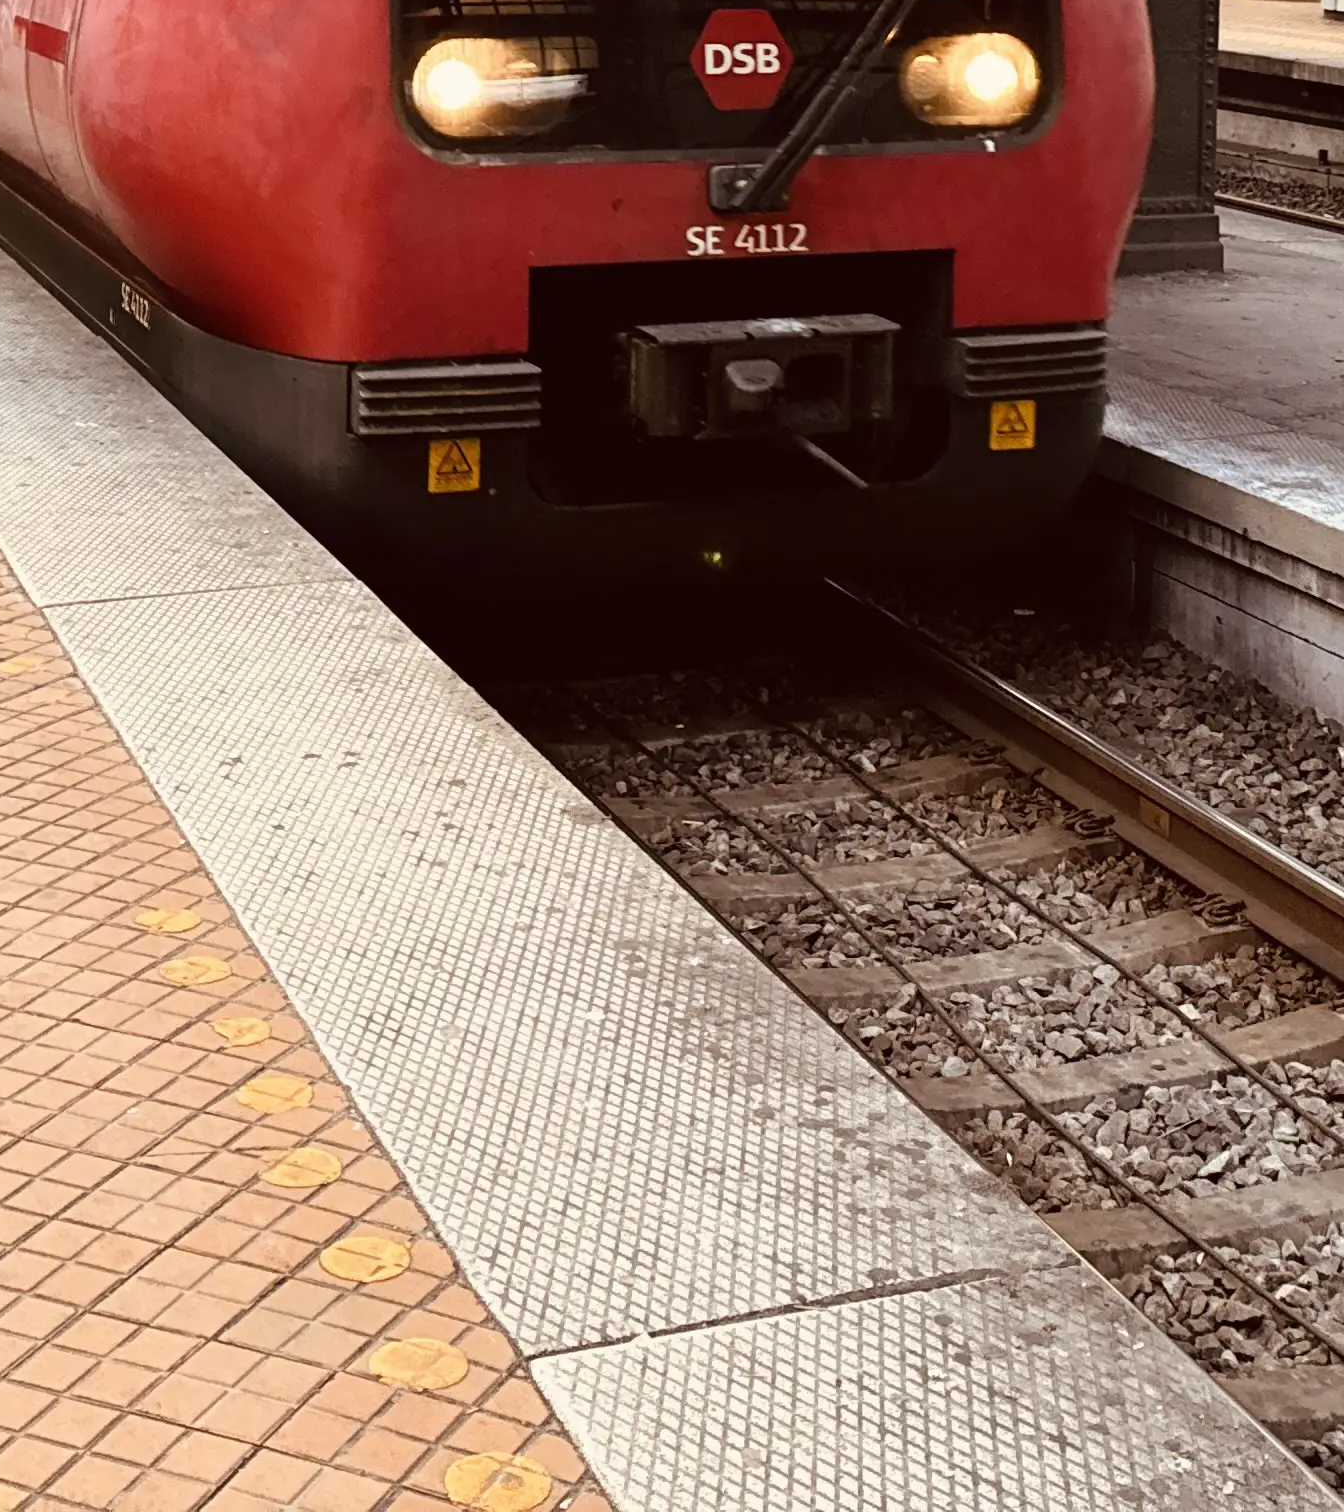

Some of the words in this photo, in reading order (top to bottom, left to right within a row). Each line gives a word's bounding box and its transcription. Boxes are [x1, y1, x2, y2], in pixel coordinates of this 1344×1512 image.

[704, 43, 781, 75] DSB
[686, 225, 725, 256] SE
[734, 223, 809, 254] 4112
